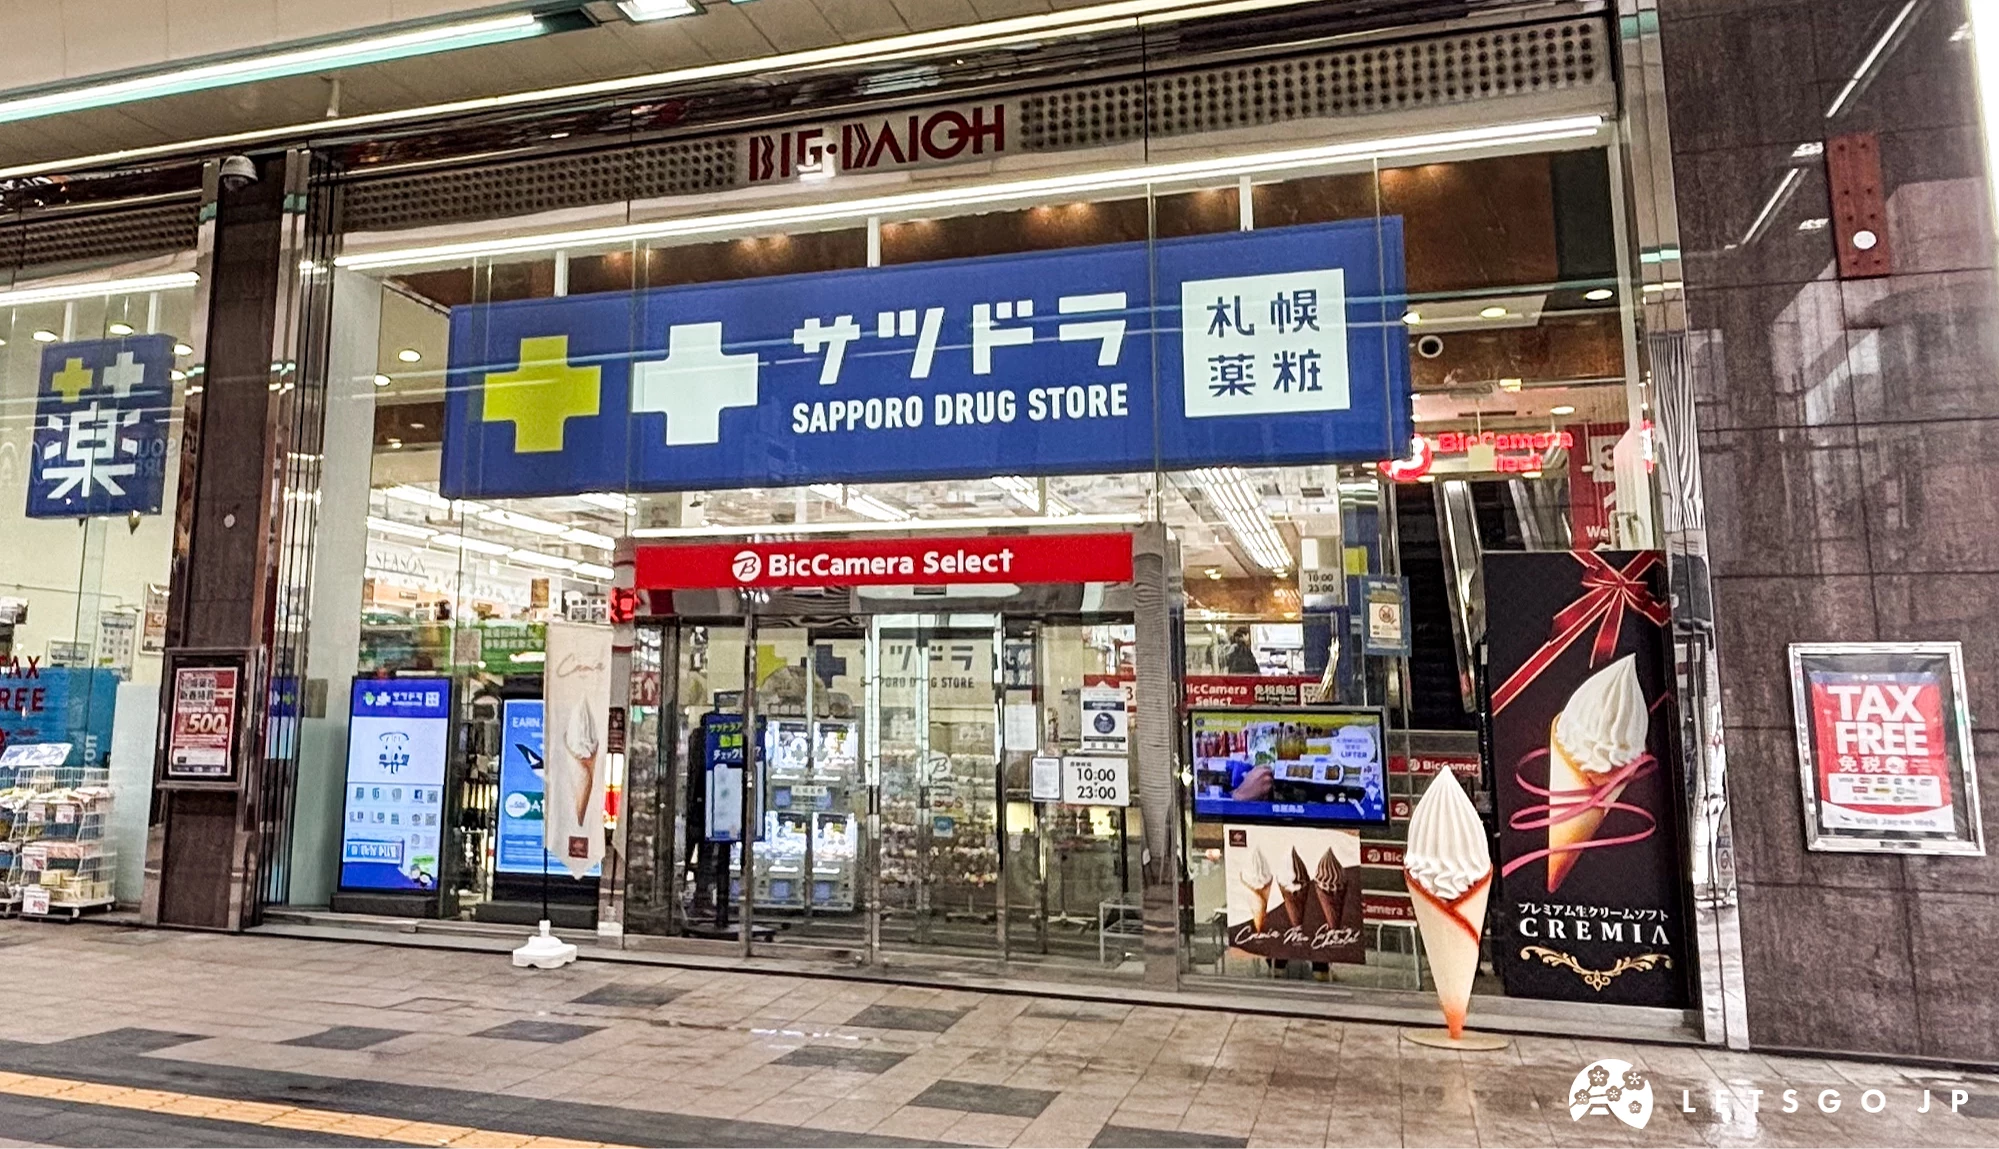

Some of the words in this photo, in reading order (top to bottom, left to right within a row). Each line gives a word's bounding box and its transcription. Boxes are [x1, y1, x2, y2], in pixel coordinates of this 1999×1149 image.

[1206, 288, 1321, 339] 札幌
[793, 291, 1127, 385] サツドラ
[1208, 348, 1324, 398] 薬粧
[792, 394, 924, 434] SAPPORO
[934, 390, 1017, 427] DRUG
[1028, 382, 1129, 421] STORE
[768, 552, 914, 578] BicCamera
[923, 548, 1014, 575] Select
[941, 677, 975, 689] STORE
[0, 687, 46, 712] REE
[1827, 685, 1926, 722] TAX
[1834, 721, 1930, 756] FREE
[1076, 767, 1116, 782] 10:00
[1076, 786, 1117, 800] 23:00
[1517, 902, 1669, 922] プレミアム生クリームソフト
[1519, 917, 1671, 946] CREMIA
